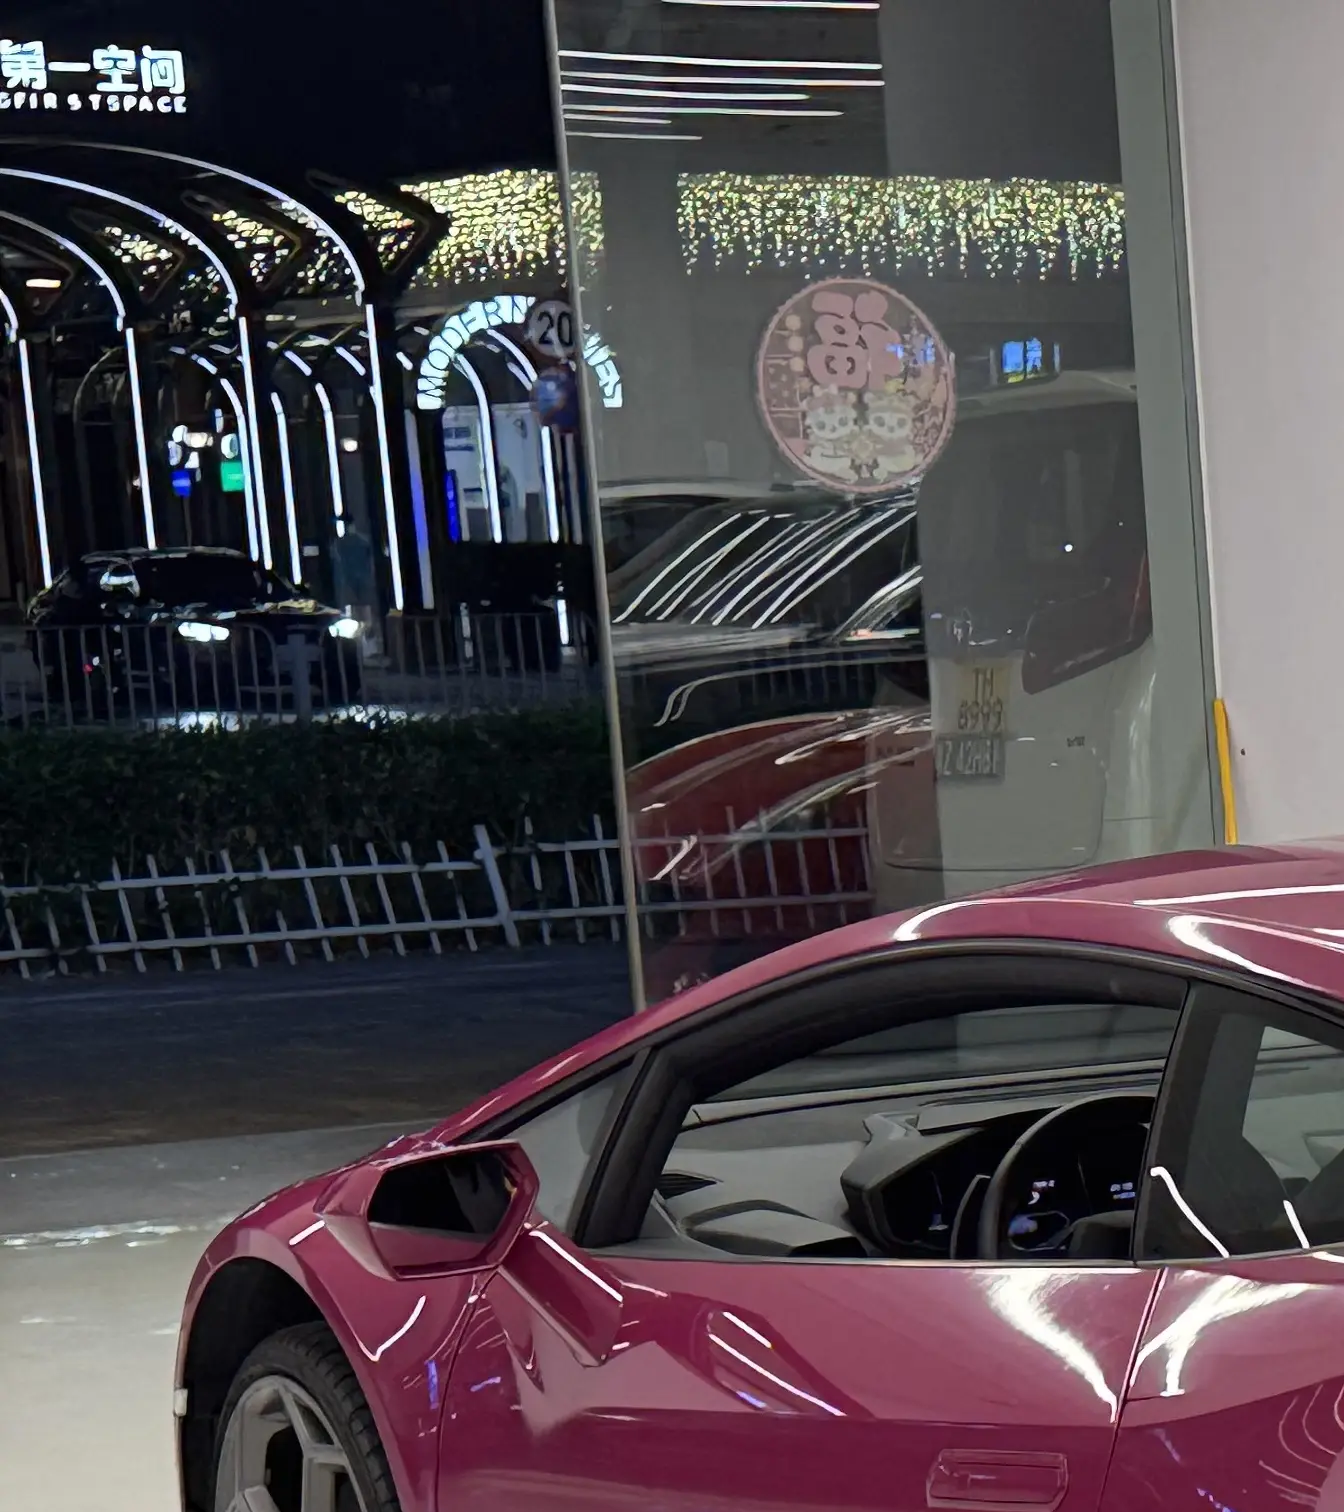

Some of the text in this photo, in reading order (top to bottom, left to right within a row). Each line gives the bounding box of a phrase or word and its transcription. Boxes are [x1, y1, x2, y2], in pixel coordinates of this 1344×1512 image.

[0, 39, 186, 95] 第一空间
[537, 311, 573, 347] 20
